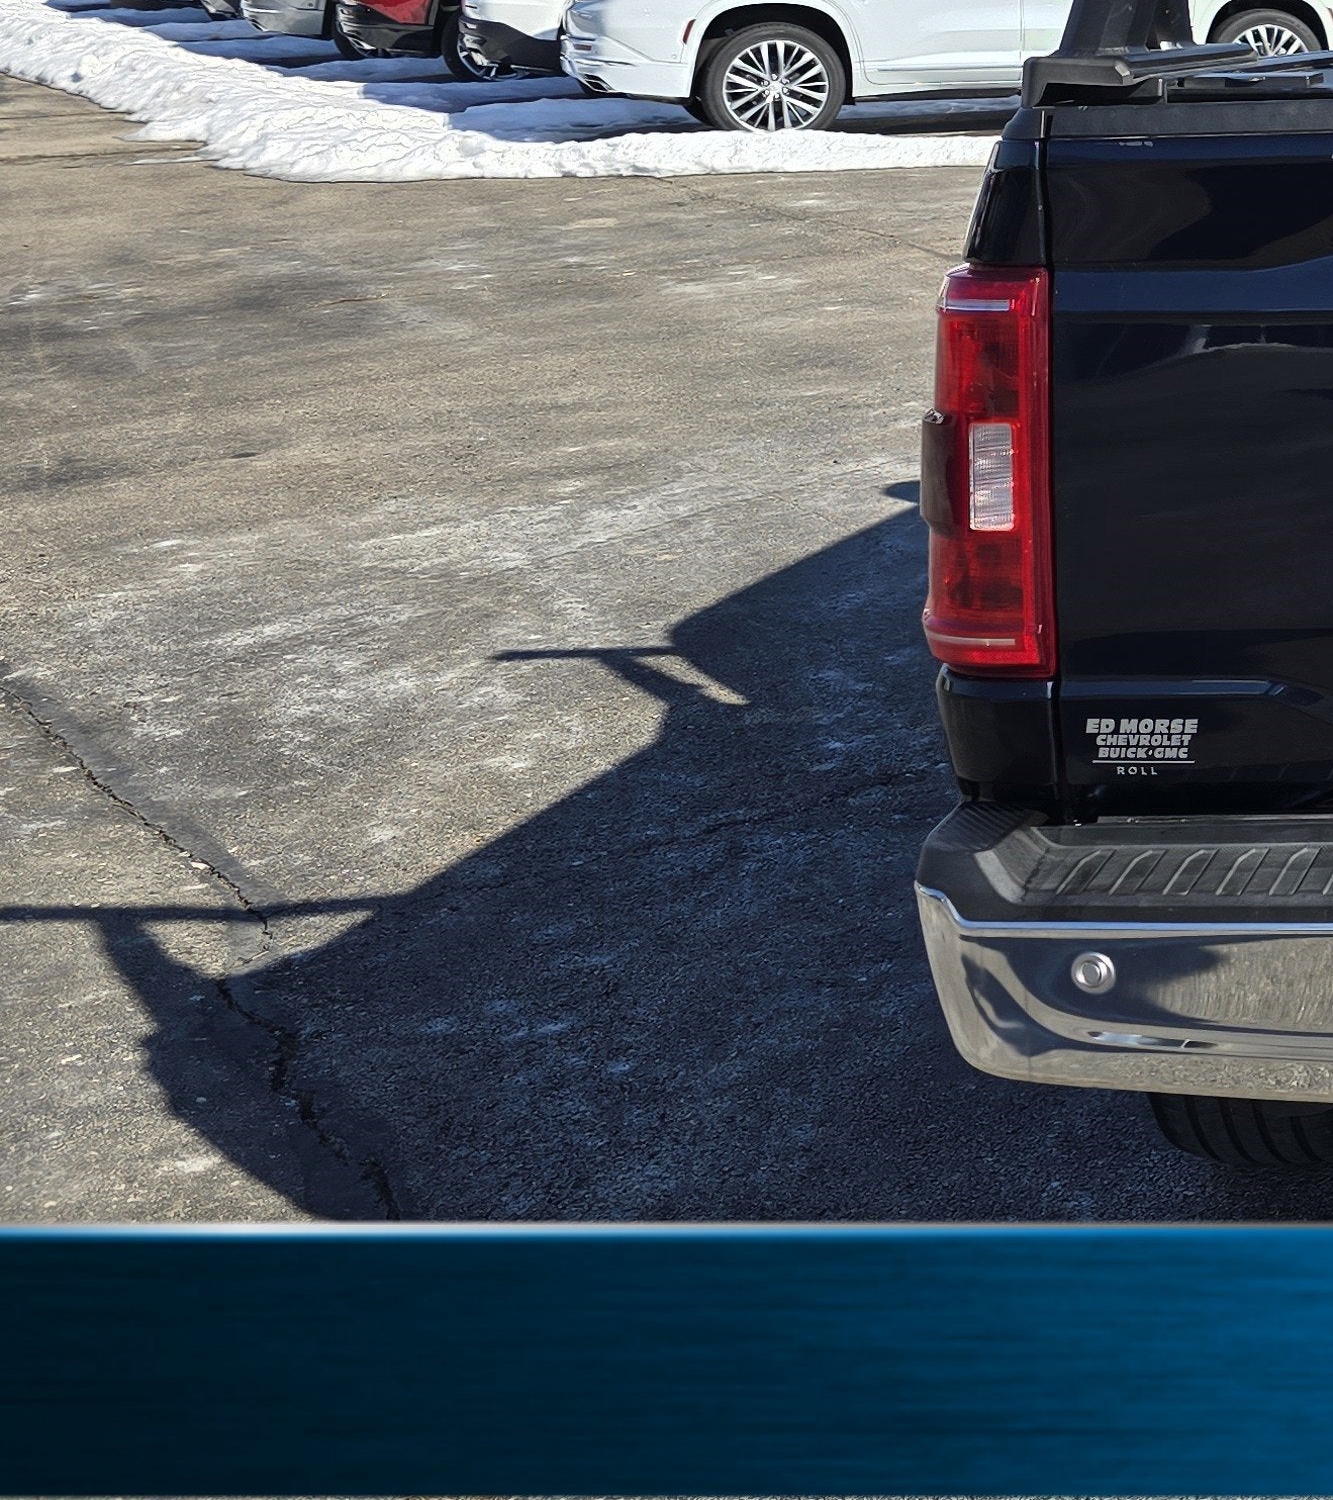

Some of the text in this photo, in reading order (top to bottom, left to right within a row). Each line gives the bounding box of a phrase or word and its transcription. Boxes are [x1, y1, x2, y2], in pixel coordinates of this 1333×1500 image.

[1086, 718, 1198, 734] ED MORSE
[1096, 734, 1191, 746] CHEVROLET
